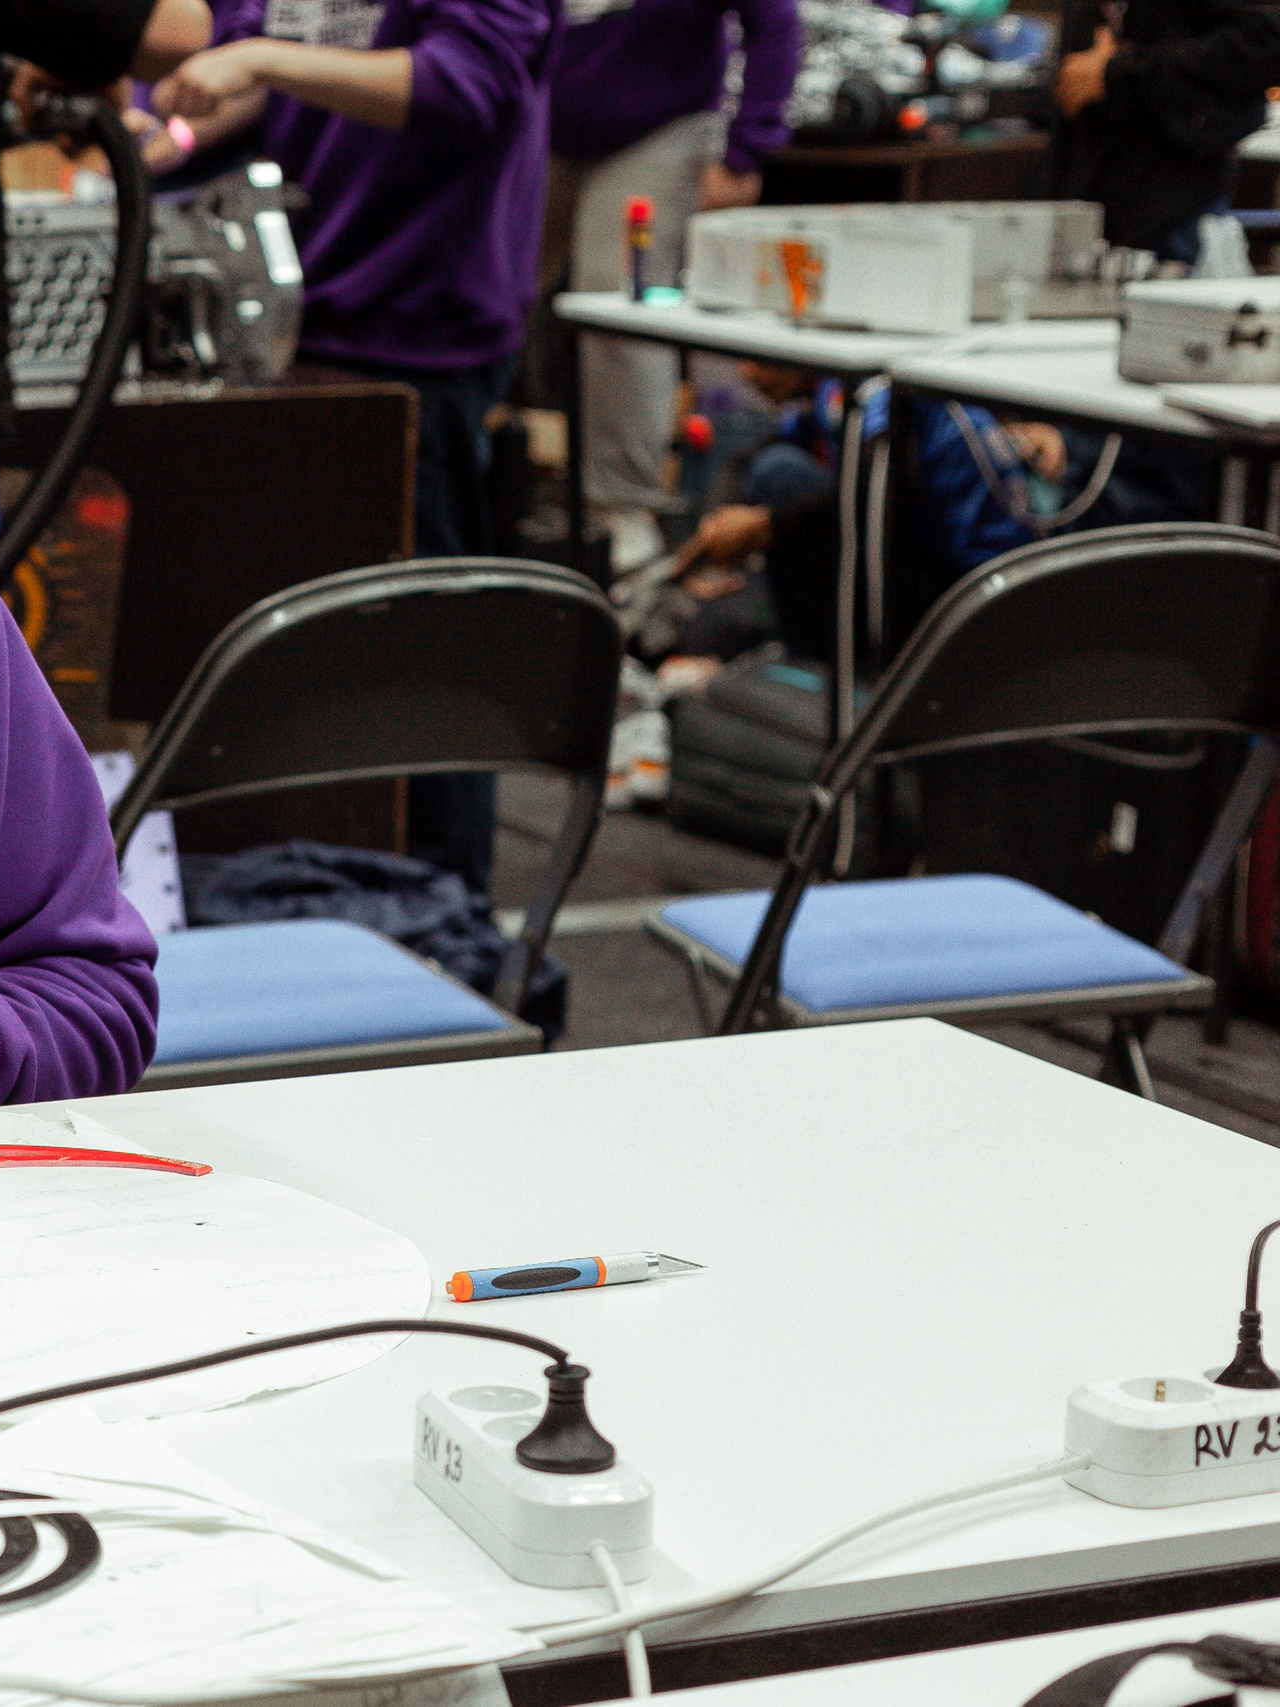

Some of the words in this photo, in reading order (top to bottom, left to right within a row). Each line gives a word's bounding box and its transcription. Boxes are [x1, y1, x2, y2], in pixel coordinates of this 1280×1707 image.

[421, 1416, 440, 1462] RV
[1195, 1420, 1240, 1467] RV
[1253, 1415, 1280, 1458] 2
